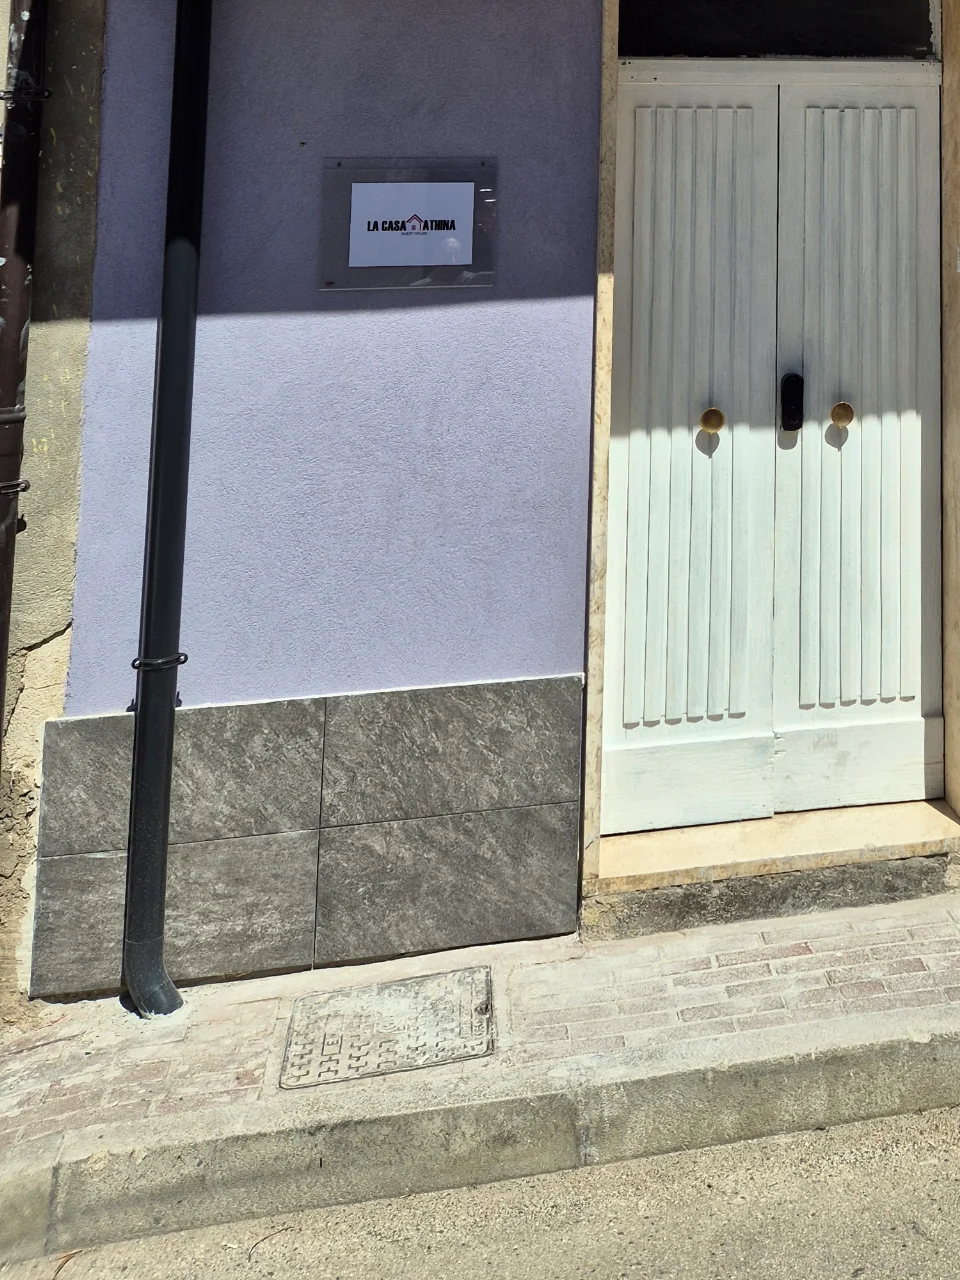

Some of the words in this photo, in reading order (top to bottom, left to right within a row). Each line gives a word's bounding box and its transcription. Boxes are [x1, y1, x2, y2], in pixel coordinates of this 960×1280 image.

[367, 220, 379, 231] LA
[381, 220, 407, 232] CASA
[422, 219, 456, 231] ATHINA
